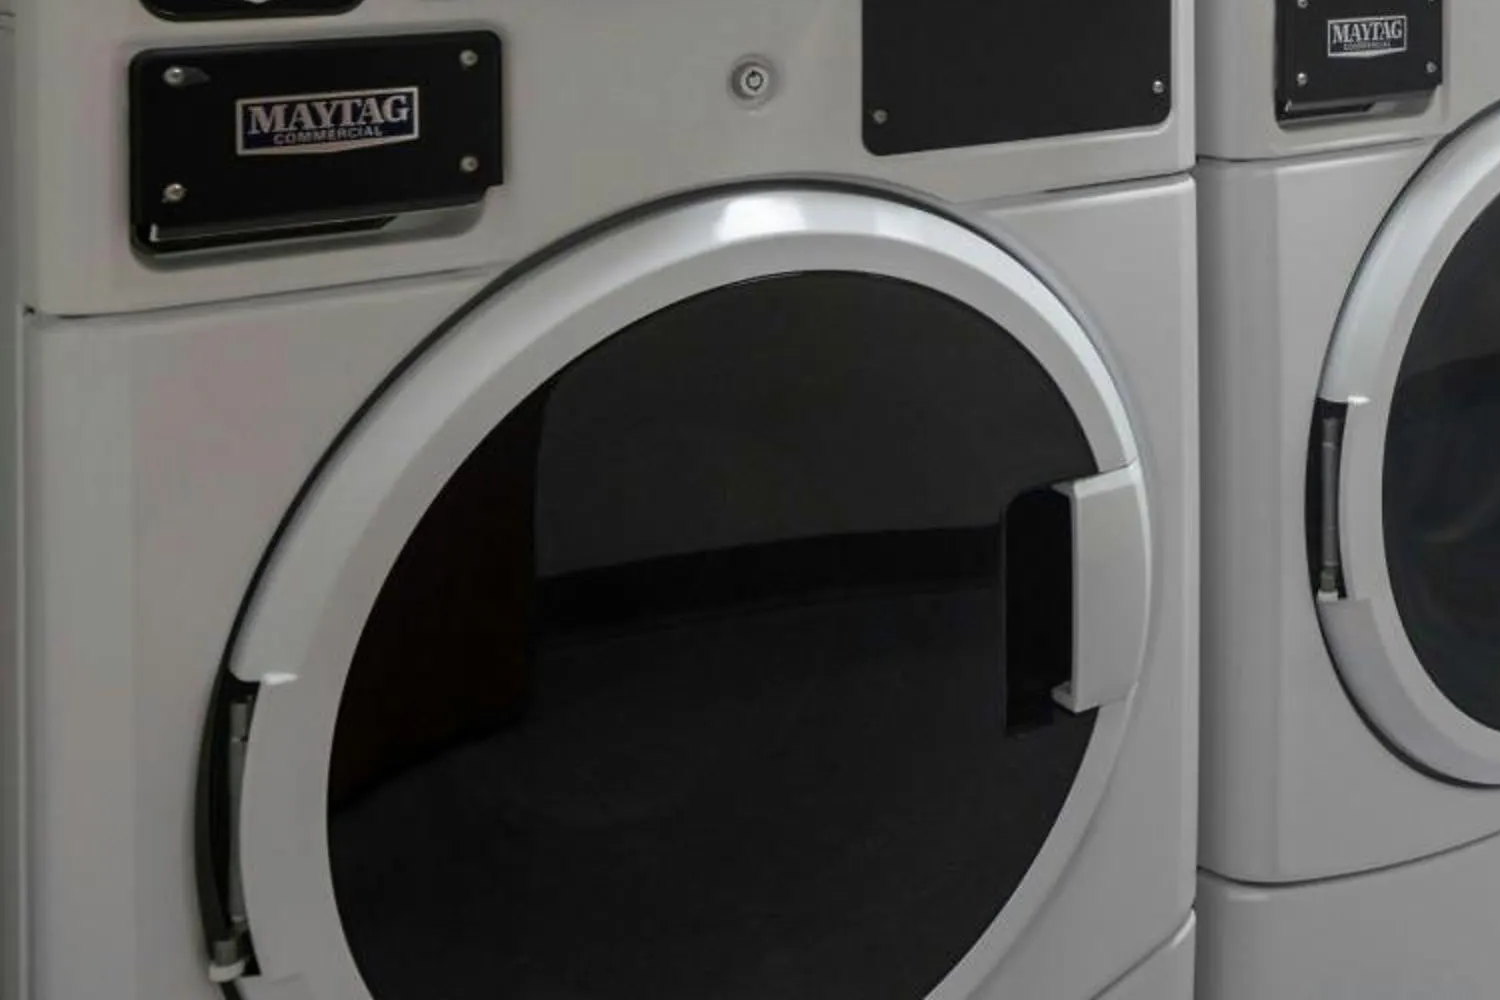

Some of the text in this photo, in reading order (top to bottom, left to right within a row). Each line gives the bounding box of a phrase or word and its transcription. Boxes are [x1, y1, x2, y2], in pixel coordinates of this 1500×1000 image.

[1332, 20, 1403, 44] MAYTAG
[247, 94, 410, 135] MAYTAG
[273, 126, 384, 145] COMMERCIAL
